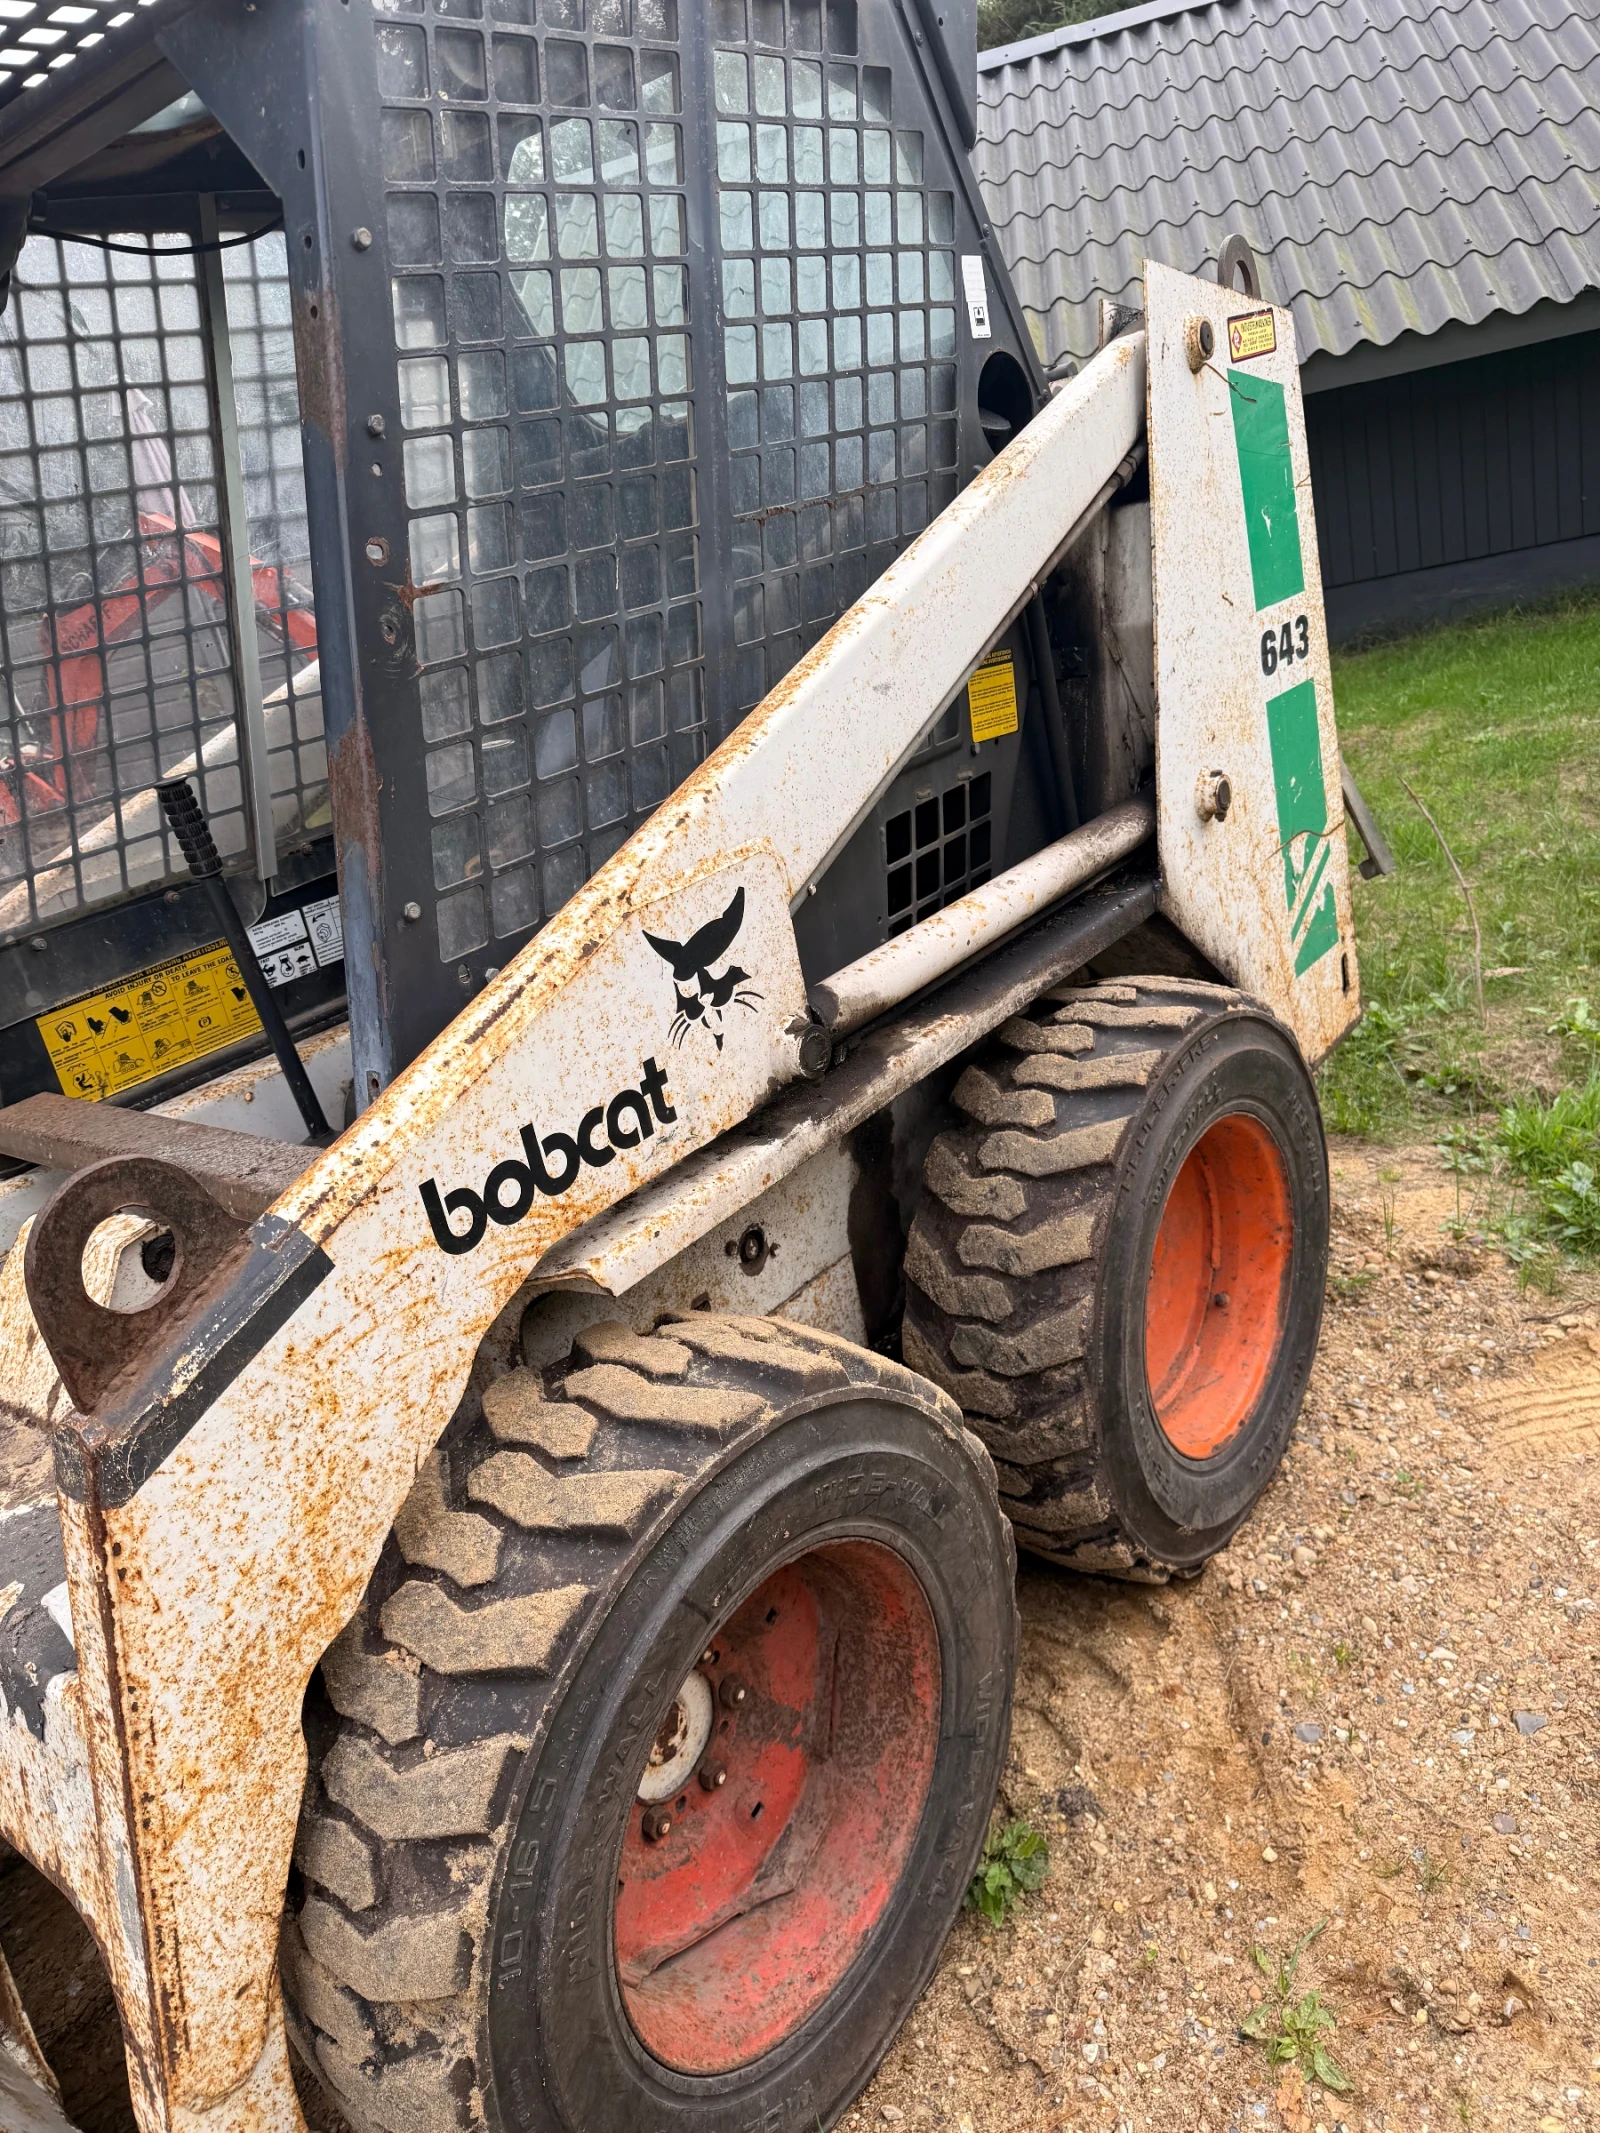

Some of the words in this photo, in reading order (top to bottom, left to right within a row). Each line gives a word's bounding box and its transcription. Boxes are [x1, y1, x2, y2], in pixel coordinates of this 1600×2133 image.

[1261, 614, 1309, 676] 643
[104, 987, 125, 1000] AVOID
[127, 977, 153, 991] INJURY
[153, 972, 164, 980] OR
[165, 963, 188, 976] DEATH
[171, 975, 181, 983] TO
[182, 966, 202, 979] LEAVE
[203, 961, 216, 970] THE
[419, 1057, 678, 1256] bobcat
[499, 1777, 557, 1982] 10-16.5
